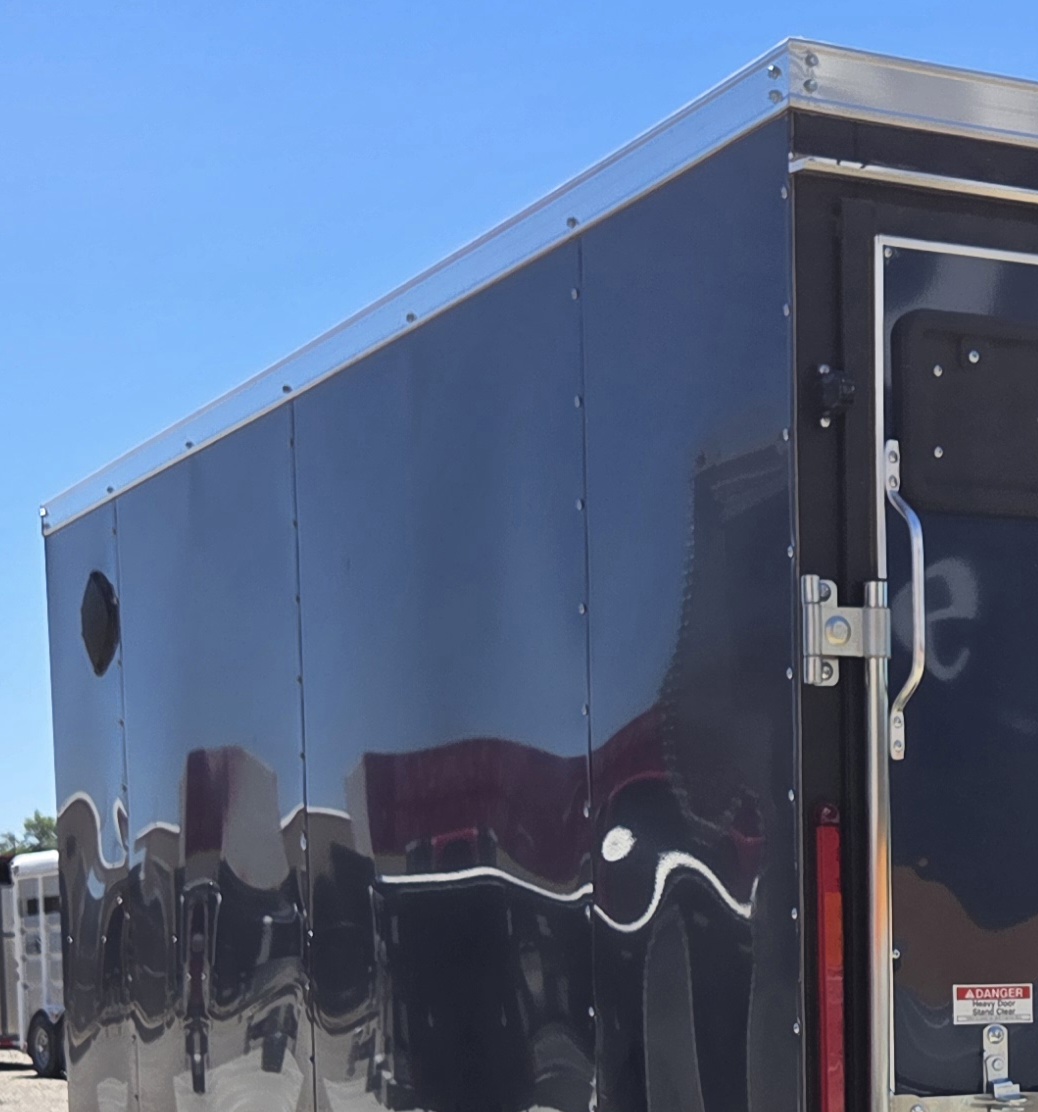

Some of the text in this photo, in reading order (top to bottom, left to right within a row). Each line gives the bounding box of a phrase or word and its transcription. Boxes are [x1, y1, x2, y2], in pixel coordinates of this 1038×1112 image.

[975, 987, 1023, 999] DANGER
[972, 1000, 995, 1009] Heavy
[972, 1008, 995, 1016] Stand
